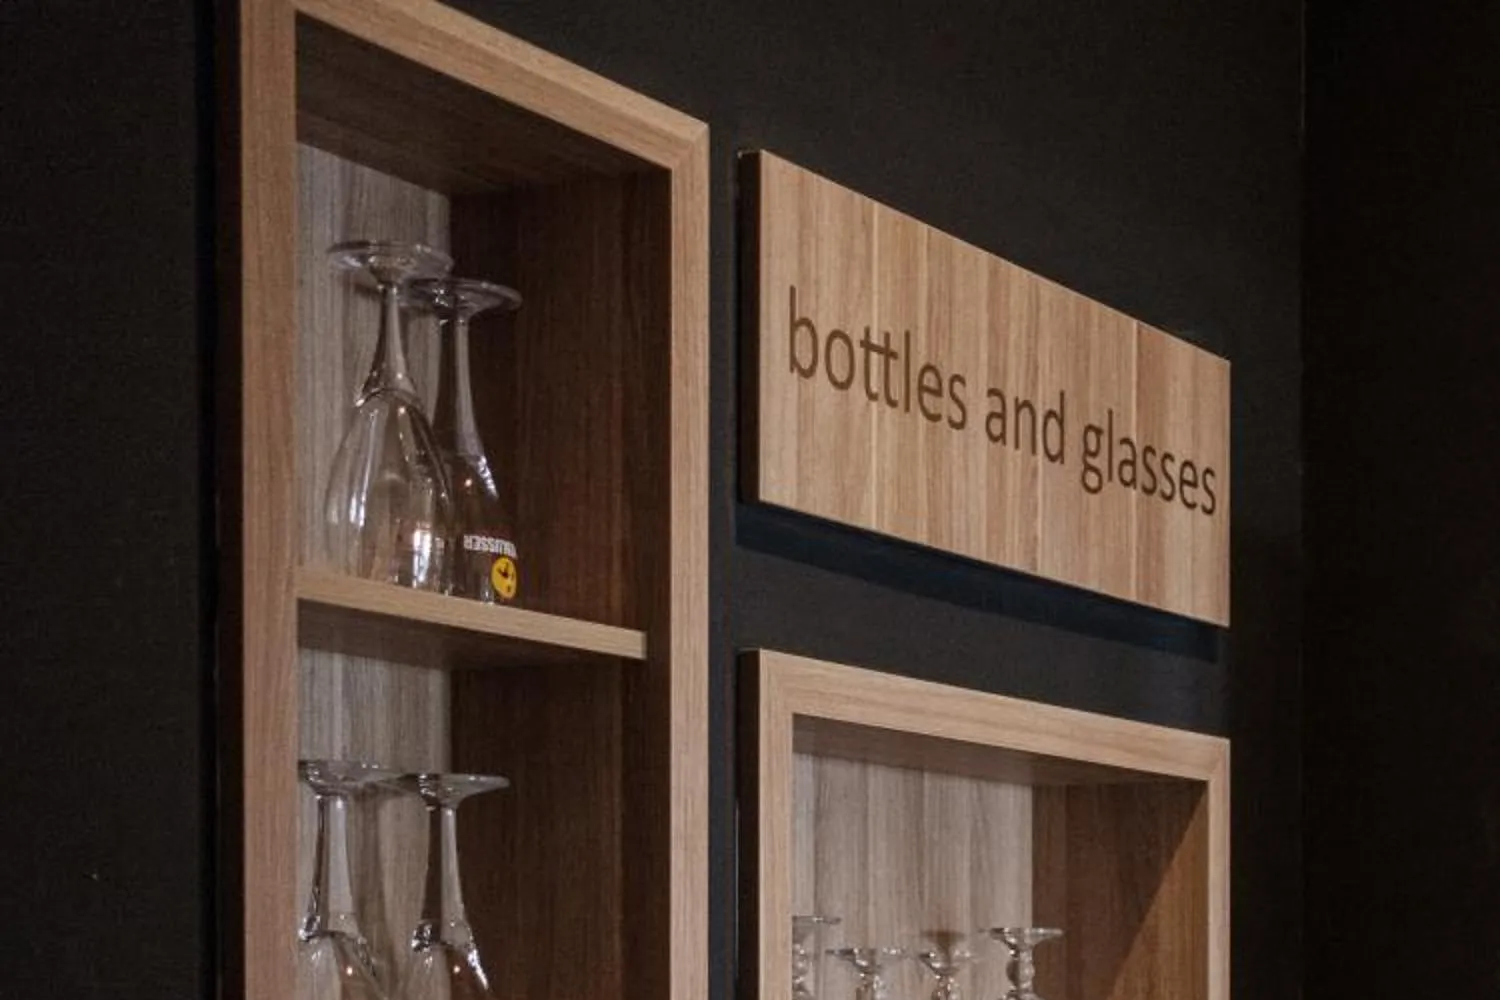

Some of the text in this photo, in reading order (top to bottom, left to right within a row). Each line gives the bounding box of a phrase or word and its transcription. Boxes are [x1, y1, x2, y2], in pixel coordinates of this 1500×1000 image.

[788, 284, 1217, 516] bottles and glasses
